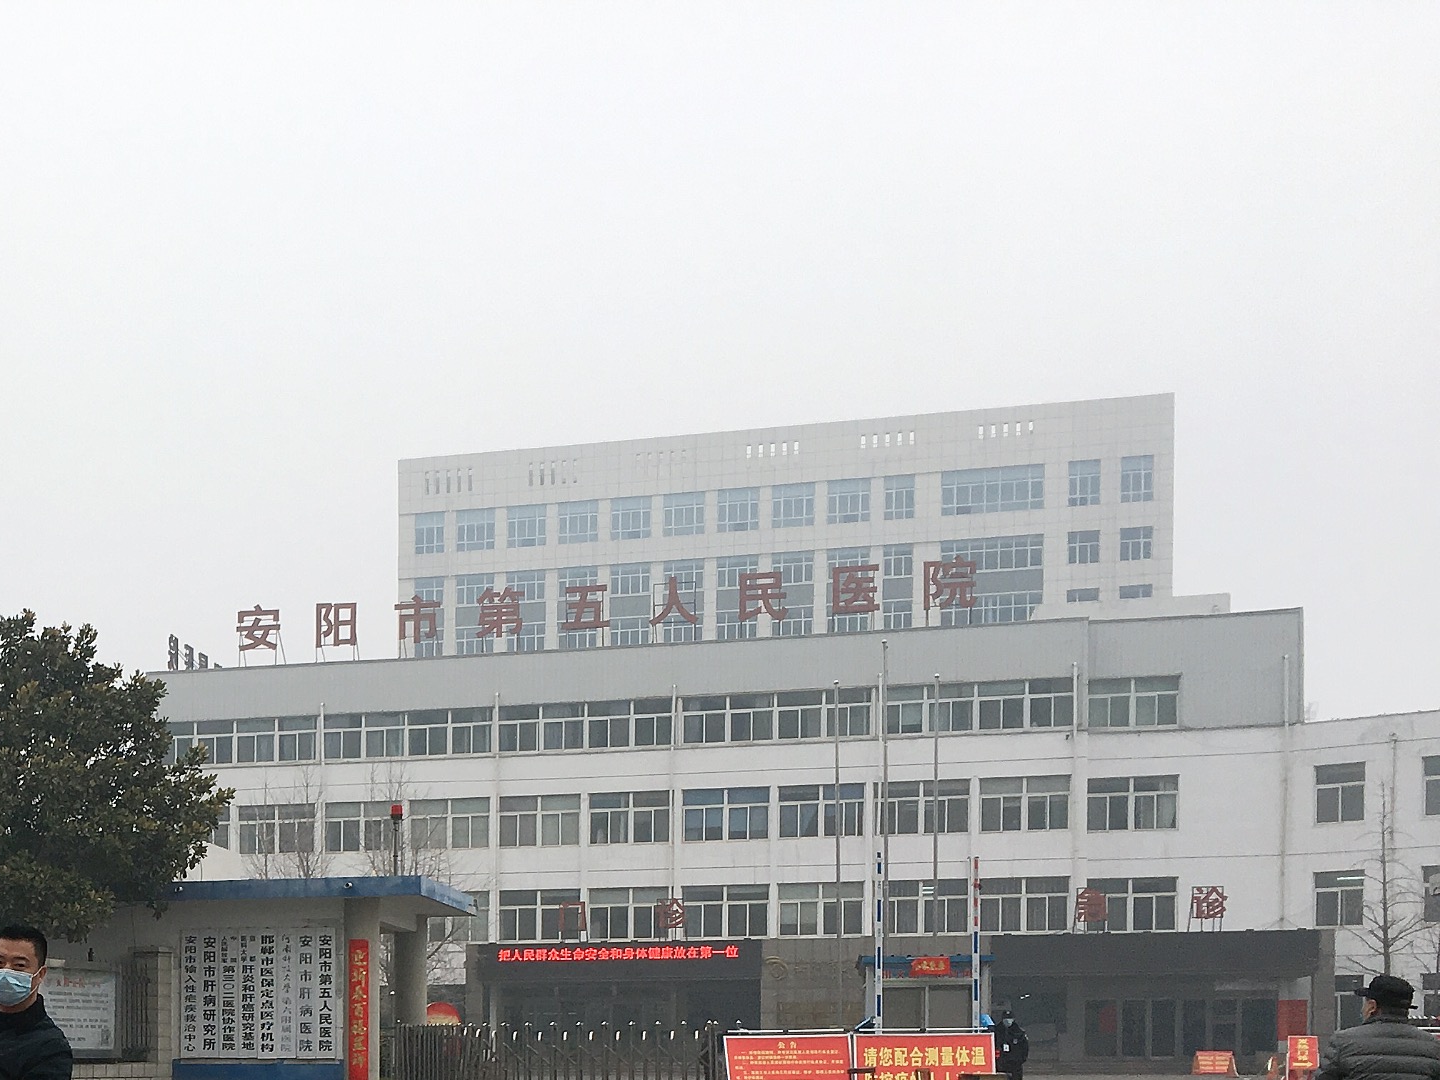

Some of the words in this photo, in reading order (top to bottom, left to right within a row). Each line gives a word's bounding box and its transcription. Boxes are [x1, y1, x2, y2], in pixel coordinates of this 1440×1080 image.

[235, 556, 978, 651] 安阳市第五人民医院
[1078, 886, 1228, 921] 急诊
[203, 936, 216, 1050] 安阳市肝病研究所
[299, 935, 312, 1052] 安阳市肝病医院
[319, 935, 332, 1052] 安阳市第五人民医院
[498, 945, 739, 962] 把人民群众生命安全和身体健康放在第一位
[863, 1046, 986, 1067] 请您配合测量体温
